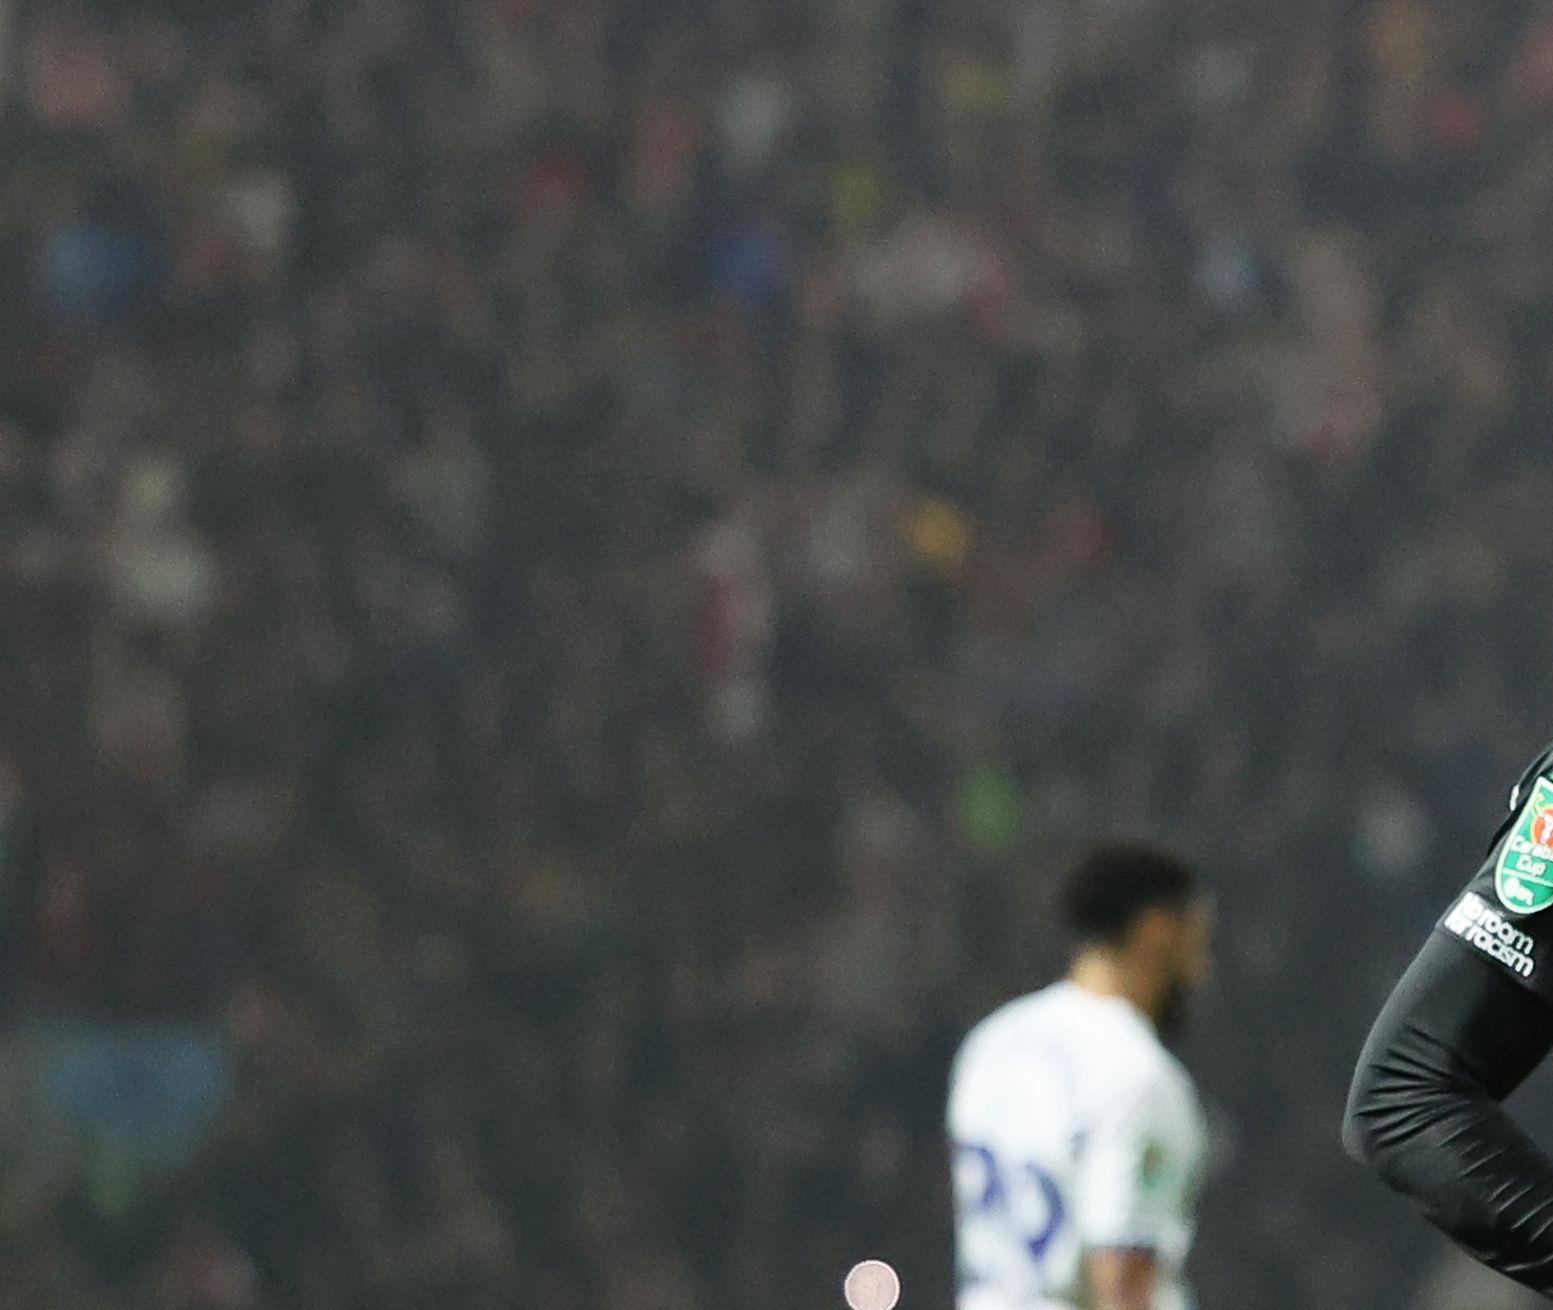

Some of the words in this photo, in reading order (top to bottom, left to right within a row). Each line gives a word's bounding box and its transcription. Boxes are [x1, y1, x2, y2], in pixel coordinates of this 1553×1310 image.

[1517, 854, 1546, 877] Cup
[1466, 925, 1534, 977] racism
[1478, 909, 1534, 955] room
